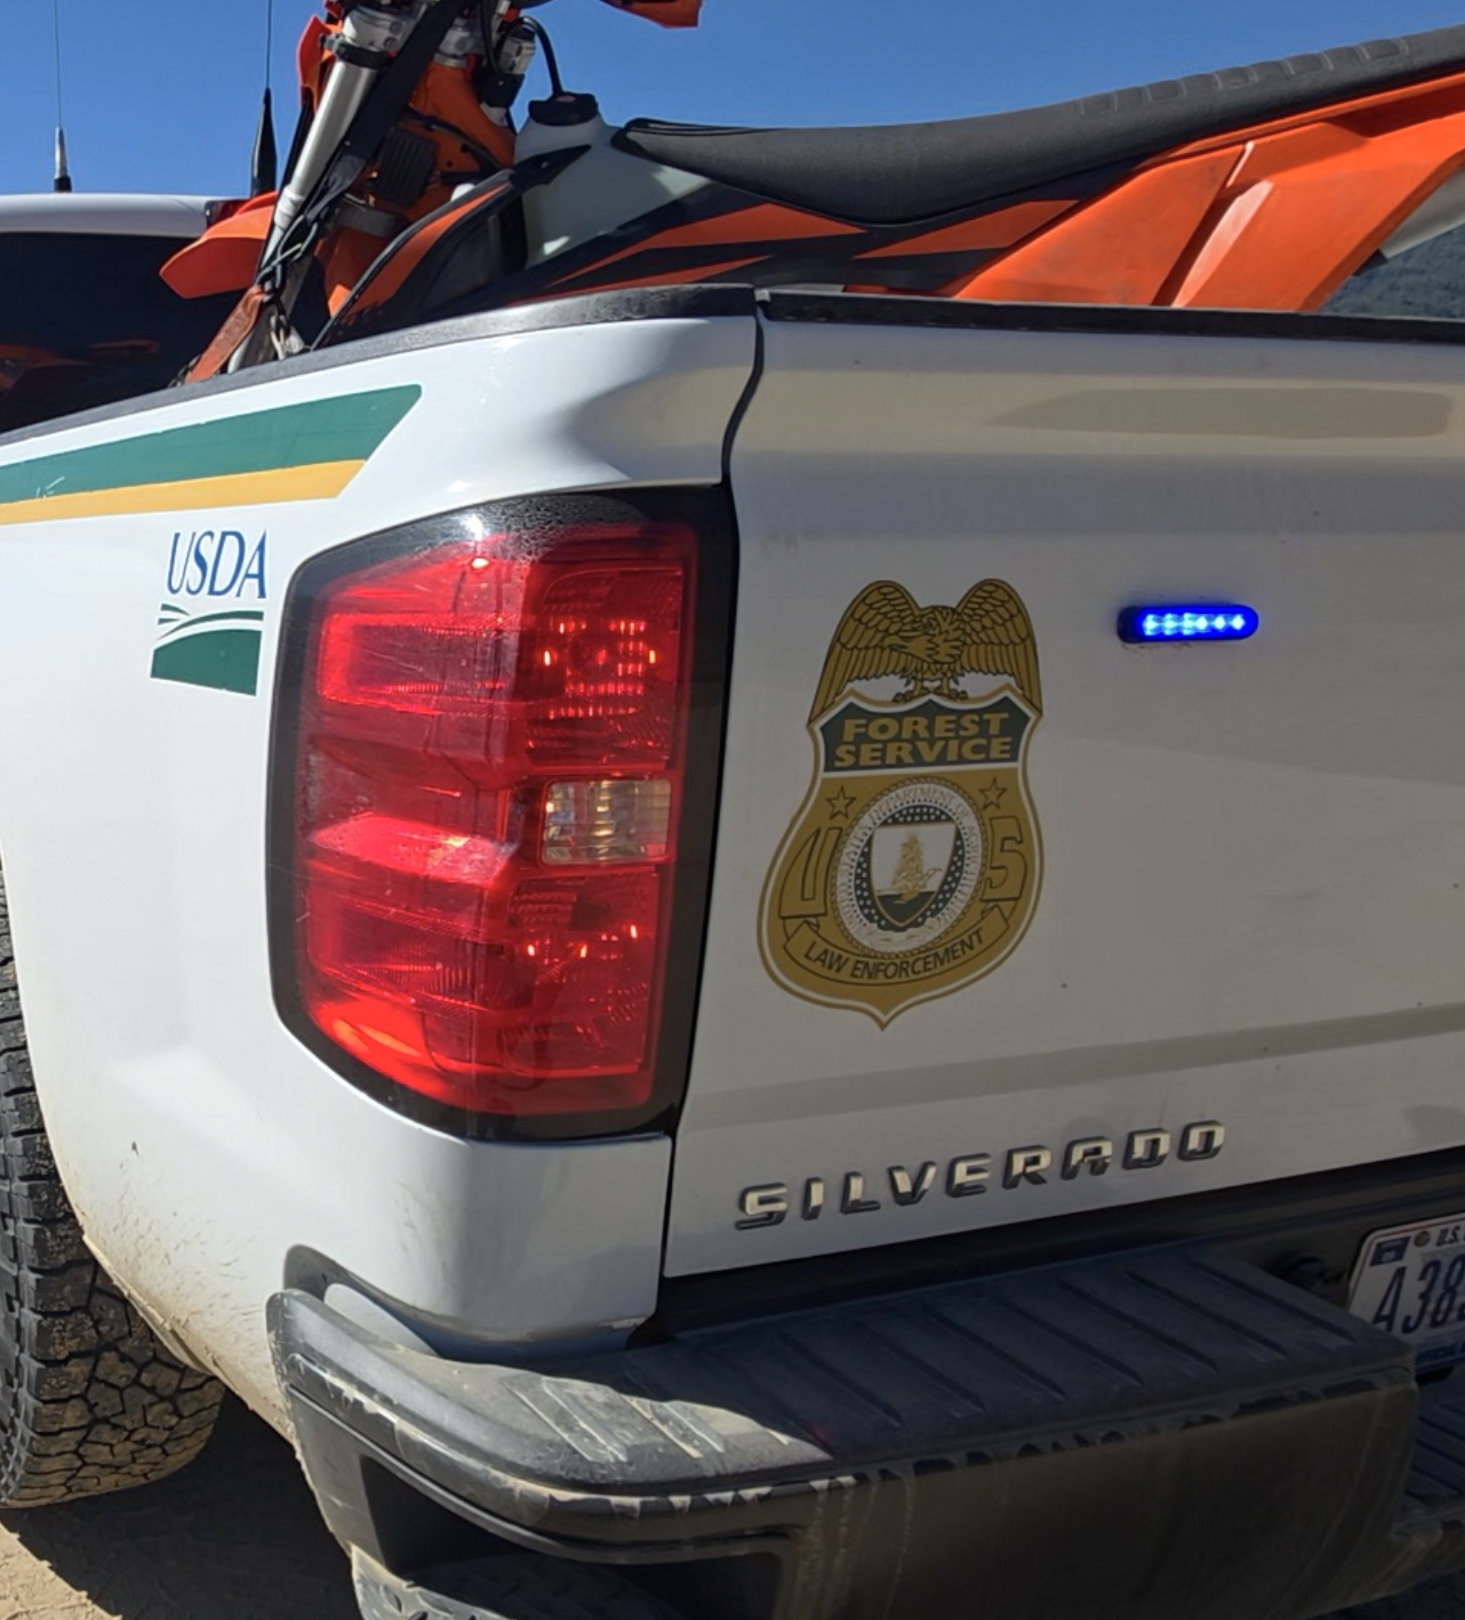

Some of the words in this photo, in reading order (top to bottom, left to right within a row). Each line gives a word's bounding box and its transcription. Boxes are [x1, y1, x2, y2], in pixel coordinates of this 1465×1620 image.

[167, 529, 268, 600] USDA
[833, 737, 1013, 768] SERVICE
[841, 712, 1010, 743] FOREST
[804, 941, 849, 974] LAW
[850, 928, 984, 980] ENFORCEMENT
[733, 1118, 1229, 1232] SILVERADO
